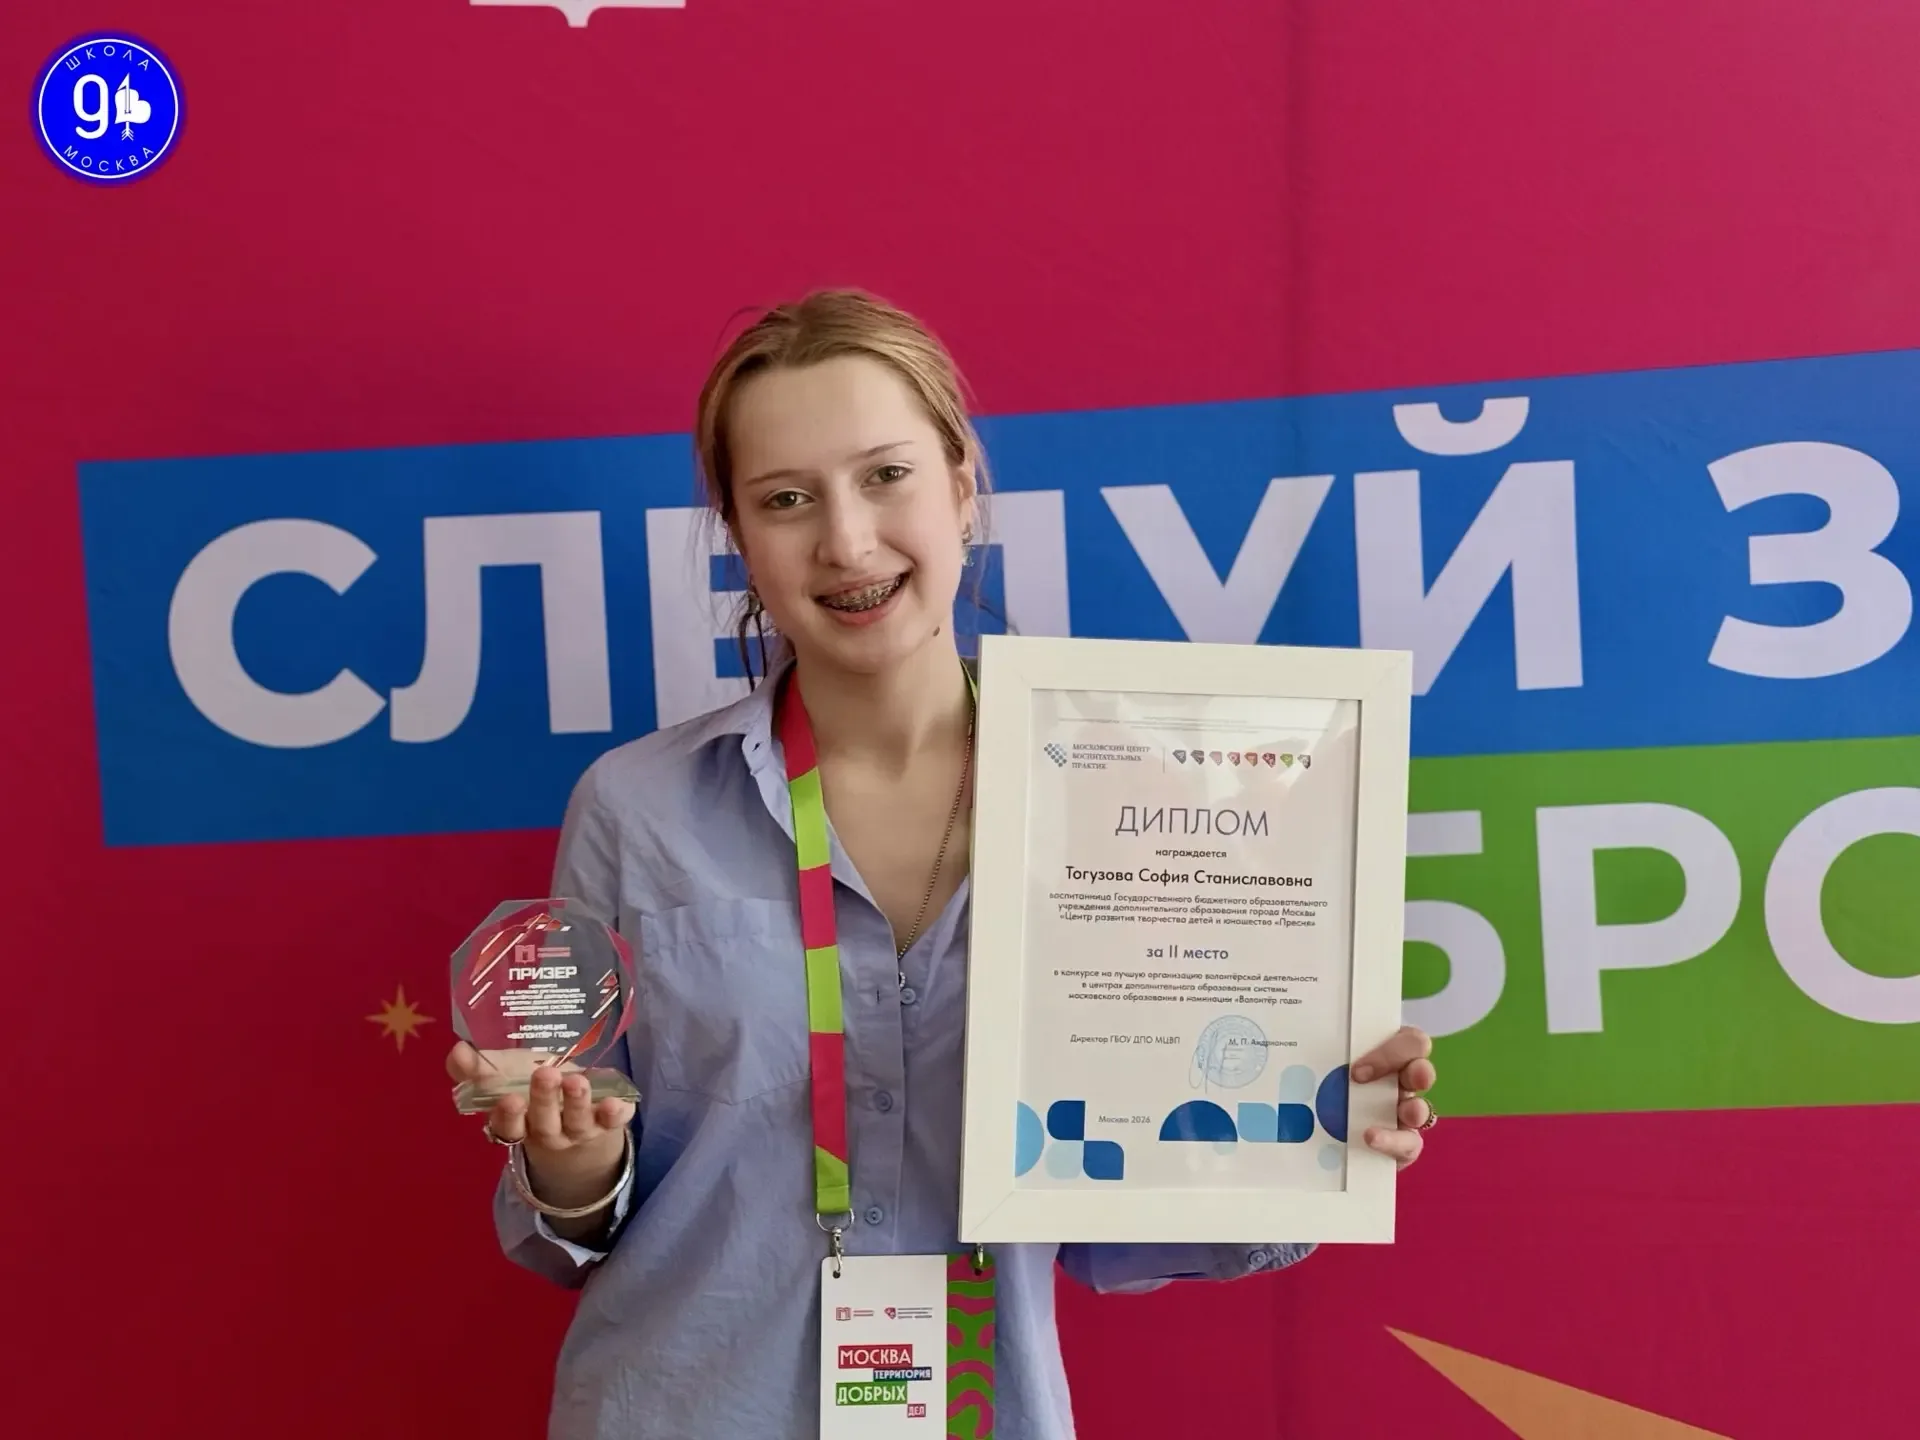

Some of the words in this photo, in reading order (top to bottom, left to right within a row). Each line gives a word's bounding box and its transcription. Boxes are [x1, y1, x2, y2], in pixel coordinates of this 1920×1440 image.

[1115, 805, 1269, 837] ДИПЛОМ
[1155, 849, 1227, 859] награждается
[1065, 866, 1134, 884] Тогузова
[1138, 868, 1189, 887] София
[1194, 869, 1313, 887] Станиславовна
[1049, 892, 1112, 901] воспитанница
[1114, 893, 1192, 904] Государственного
[1194, 895, 1247, 905] бюджетного
[1249, 897, 1328, 908] образовательного
[1058, 902, 1111, 912] учреждения
[1112, 903, 1188, 914] дополнительного
[1190, 905, 1247, 915] образования
[1249, 909, 1280, 917] города
[1281, 908, 1316, 917] Москвы
[1060, 911, 1093, 922] «Центр
[1095, 914, 1135, 923] развития
[1188, 916, 1214, 924] детей
[1274, 917, 1316, 928] «Пресня»
[1146, 948, 1164, 958] за
[1183, 948, 1229, 960] место
[508, 966, 578, 981] ПРИЗЕР
[1061, 969, 1100, 978] конкурсе
[1114, 971, 1145, 979] лучшую
[1147, 971, 1203, 980] организацию
[1205, 972, 1262, 982] волонтёрской
[1263, 975, 1319, 983] деятельности
[1089, 982, 1123, 990] центрах
[1125, 983, 1196, 991] дополнительного
[1197, 983, 1251, 992] образования
[1122, 993, 1177, 1002] образования
[1186, 996, 1233, 1004] номинации
[1279, 997, 1303, 1005] года»
[1070, 1034, 1109, 1044] Директор
[1110, 1035, 1132, 1044] ГБОУ
[1132, 1035, 1153, 1044] ДПО
[1098, 1115, 1130, 1123] Москва
[840, 1348, 912, 1366] МОСКВА
[874, 1368, 931, 1380] ТЕРРИТОРИЯ
[837, 1385, 906, 1405] ДОБРЫХ
[908, 1405, 925, 1417] ДЕЛ
